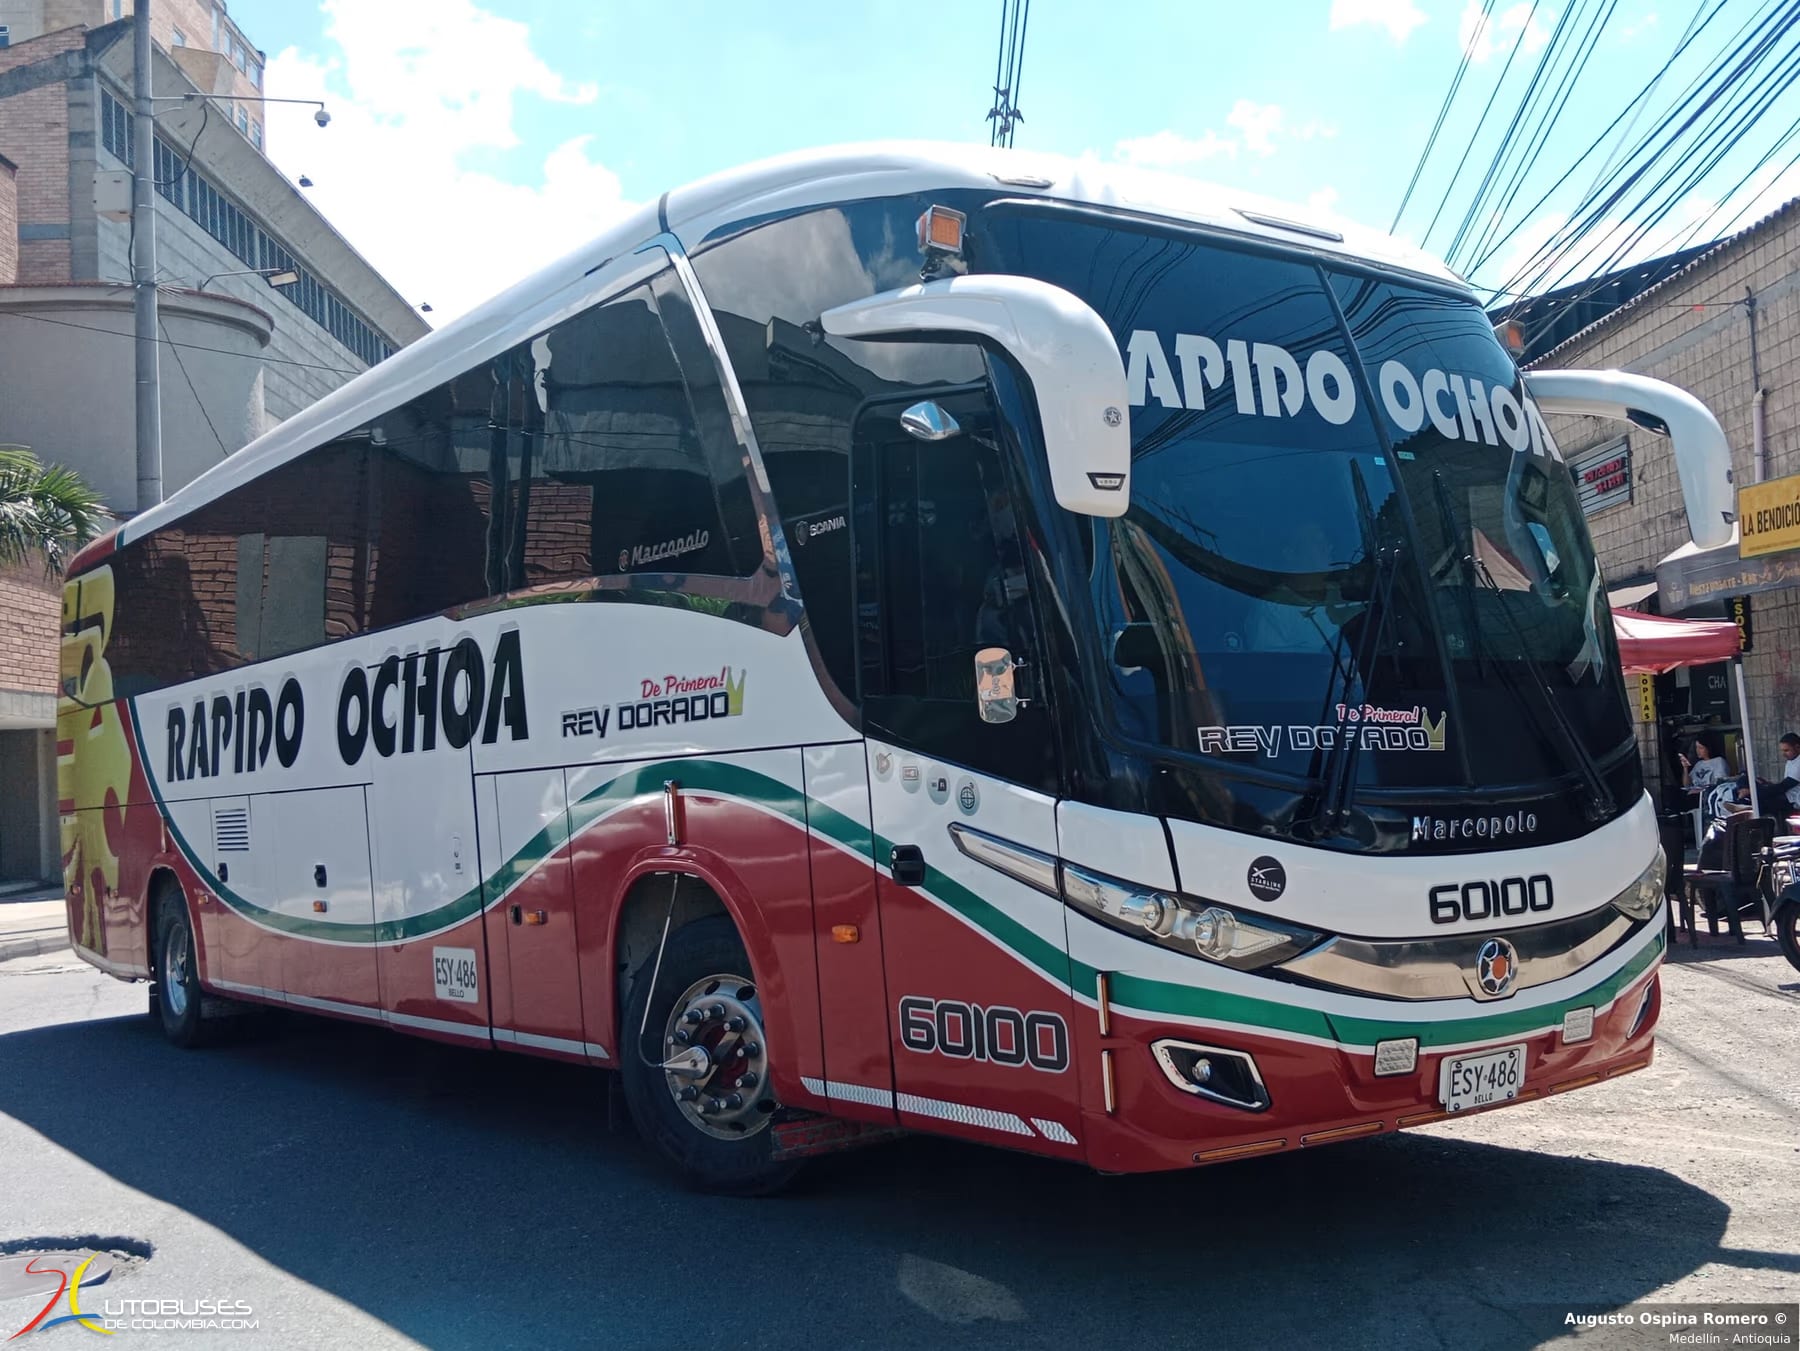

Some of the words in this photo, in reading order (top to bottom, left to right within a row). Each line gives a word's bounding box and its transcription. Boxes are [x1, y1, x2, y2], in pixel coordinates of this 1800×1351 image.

[1127, 329, 1356, 425] APIDO
[1379, 360, 1562, 463] OCHOA
[809, 515, 847, 537] SCANIA
[1741, 513, 1755, 537] LA
[631, 529, 709, 565] Marcopolo
[641, 679, 661, 698] De
[663, 665, 727, 695] Primera!
[1641, 673, 1650, 720] OPIAS
[165, 671, 304, 783] RAPIDO
[336, 622, 529, 766] OCHOA
[561, 705, 611, 738] REY
[617, 690, 730, 731] DORADO
[1359, 704, 1420, 724] Primera!
[1197, 726, 1281, 758] REY
[1411, 811, 1538, 841] Marcopolo
[1428, 873, 1554, 925] 60100
[898, 994, 1071, 1074] 60100
